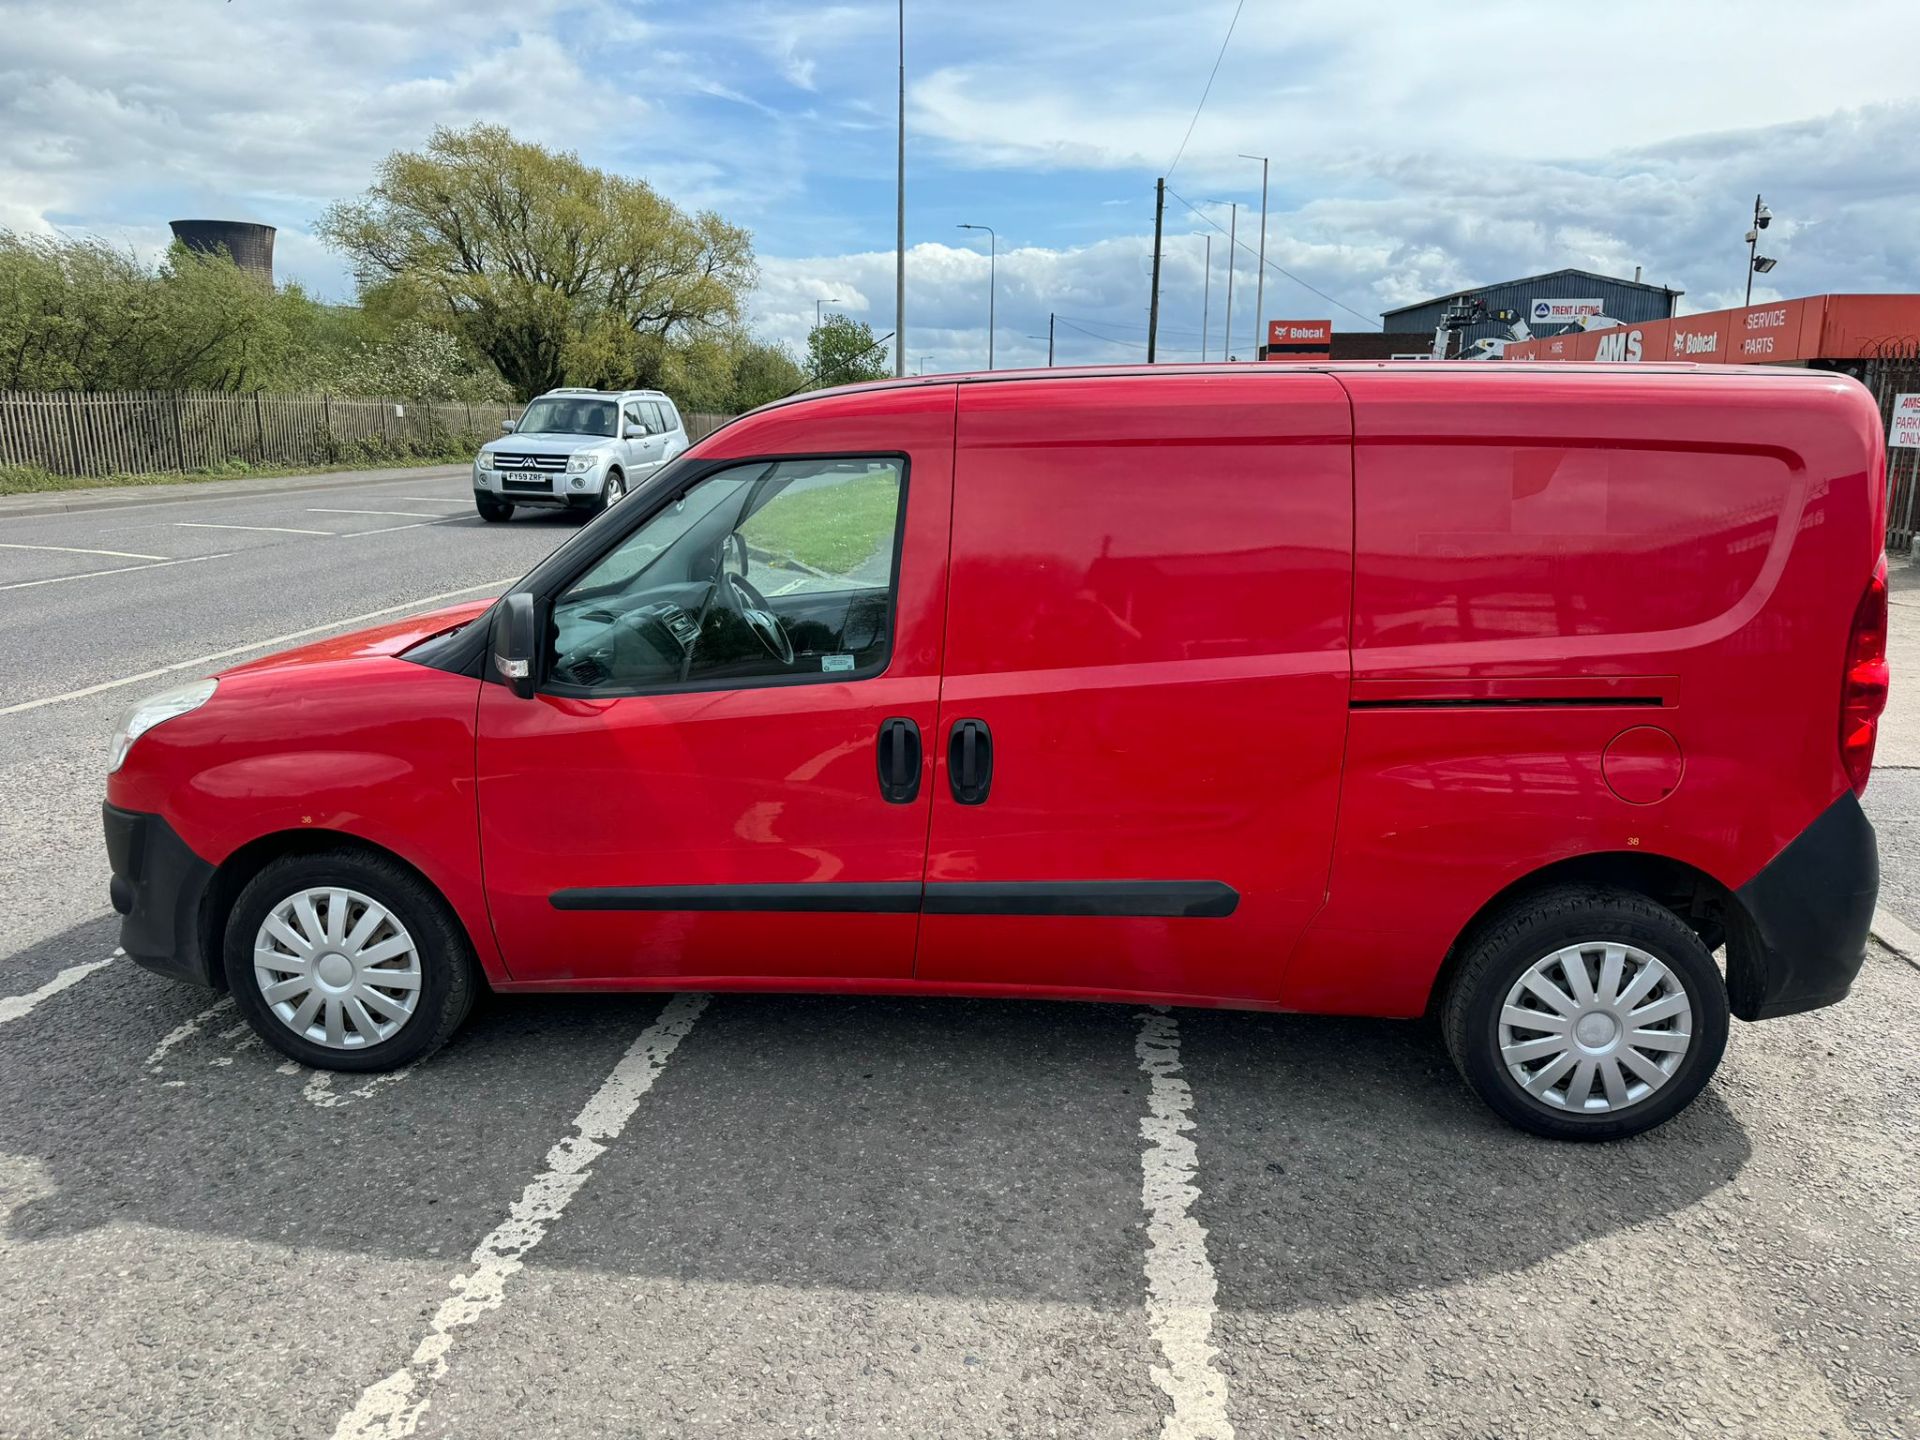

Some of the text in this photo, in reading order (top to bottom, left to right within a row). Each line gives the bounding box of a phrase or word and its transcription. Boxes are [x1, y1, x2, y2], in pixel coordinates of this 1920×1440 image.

[1552, 305, 1600, 315] TRENT LIFTING
[1747, 309, 1786, 329] SERVICE
[1290, 327, 1324, 339] Bobcat
[1594, 330, 1643, 362] AMS
[1686, 331, 1718, 354] Bobcat
[1744, 337, 1774, 355] PARTS
[509, 472, 543, 481] FY59 ZRF
[1627, 837, 1640, 846] 38
